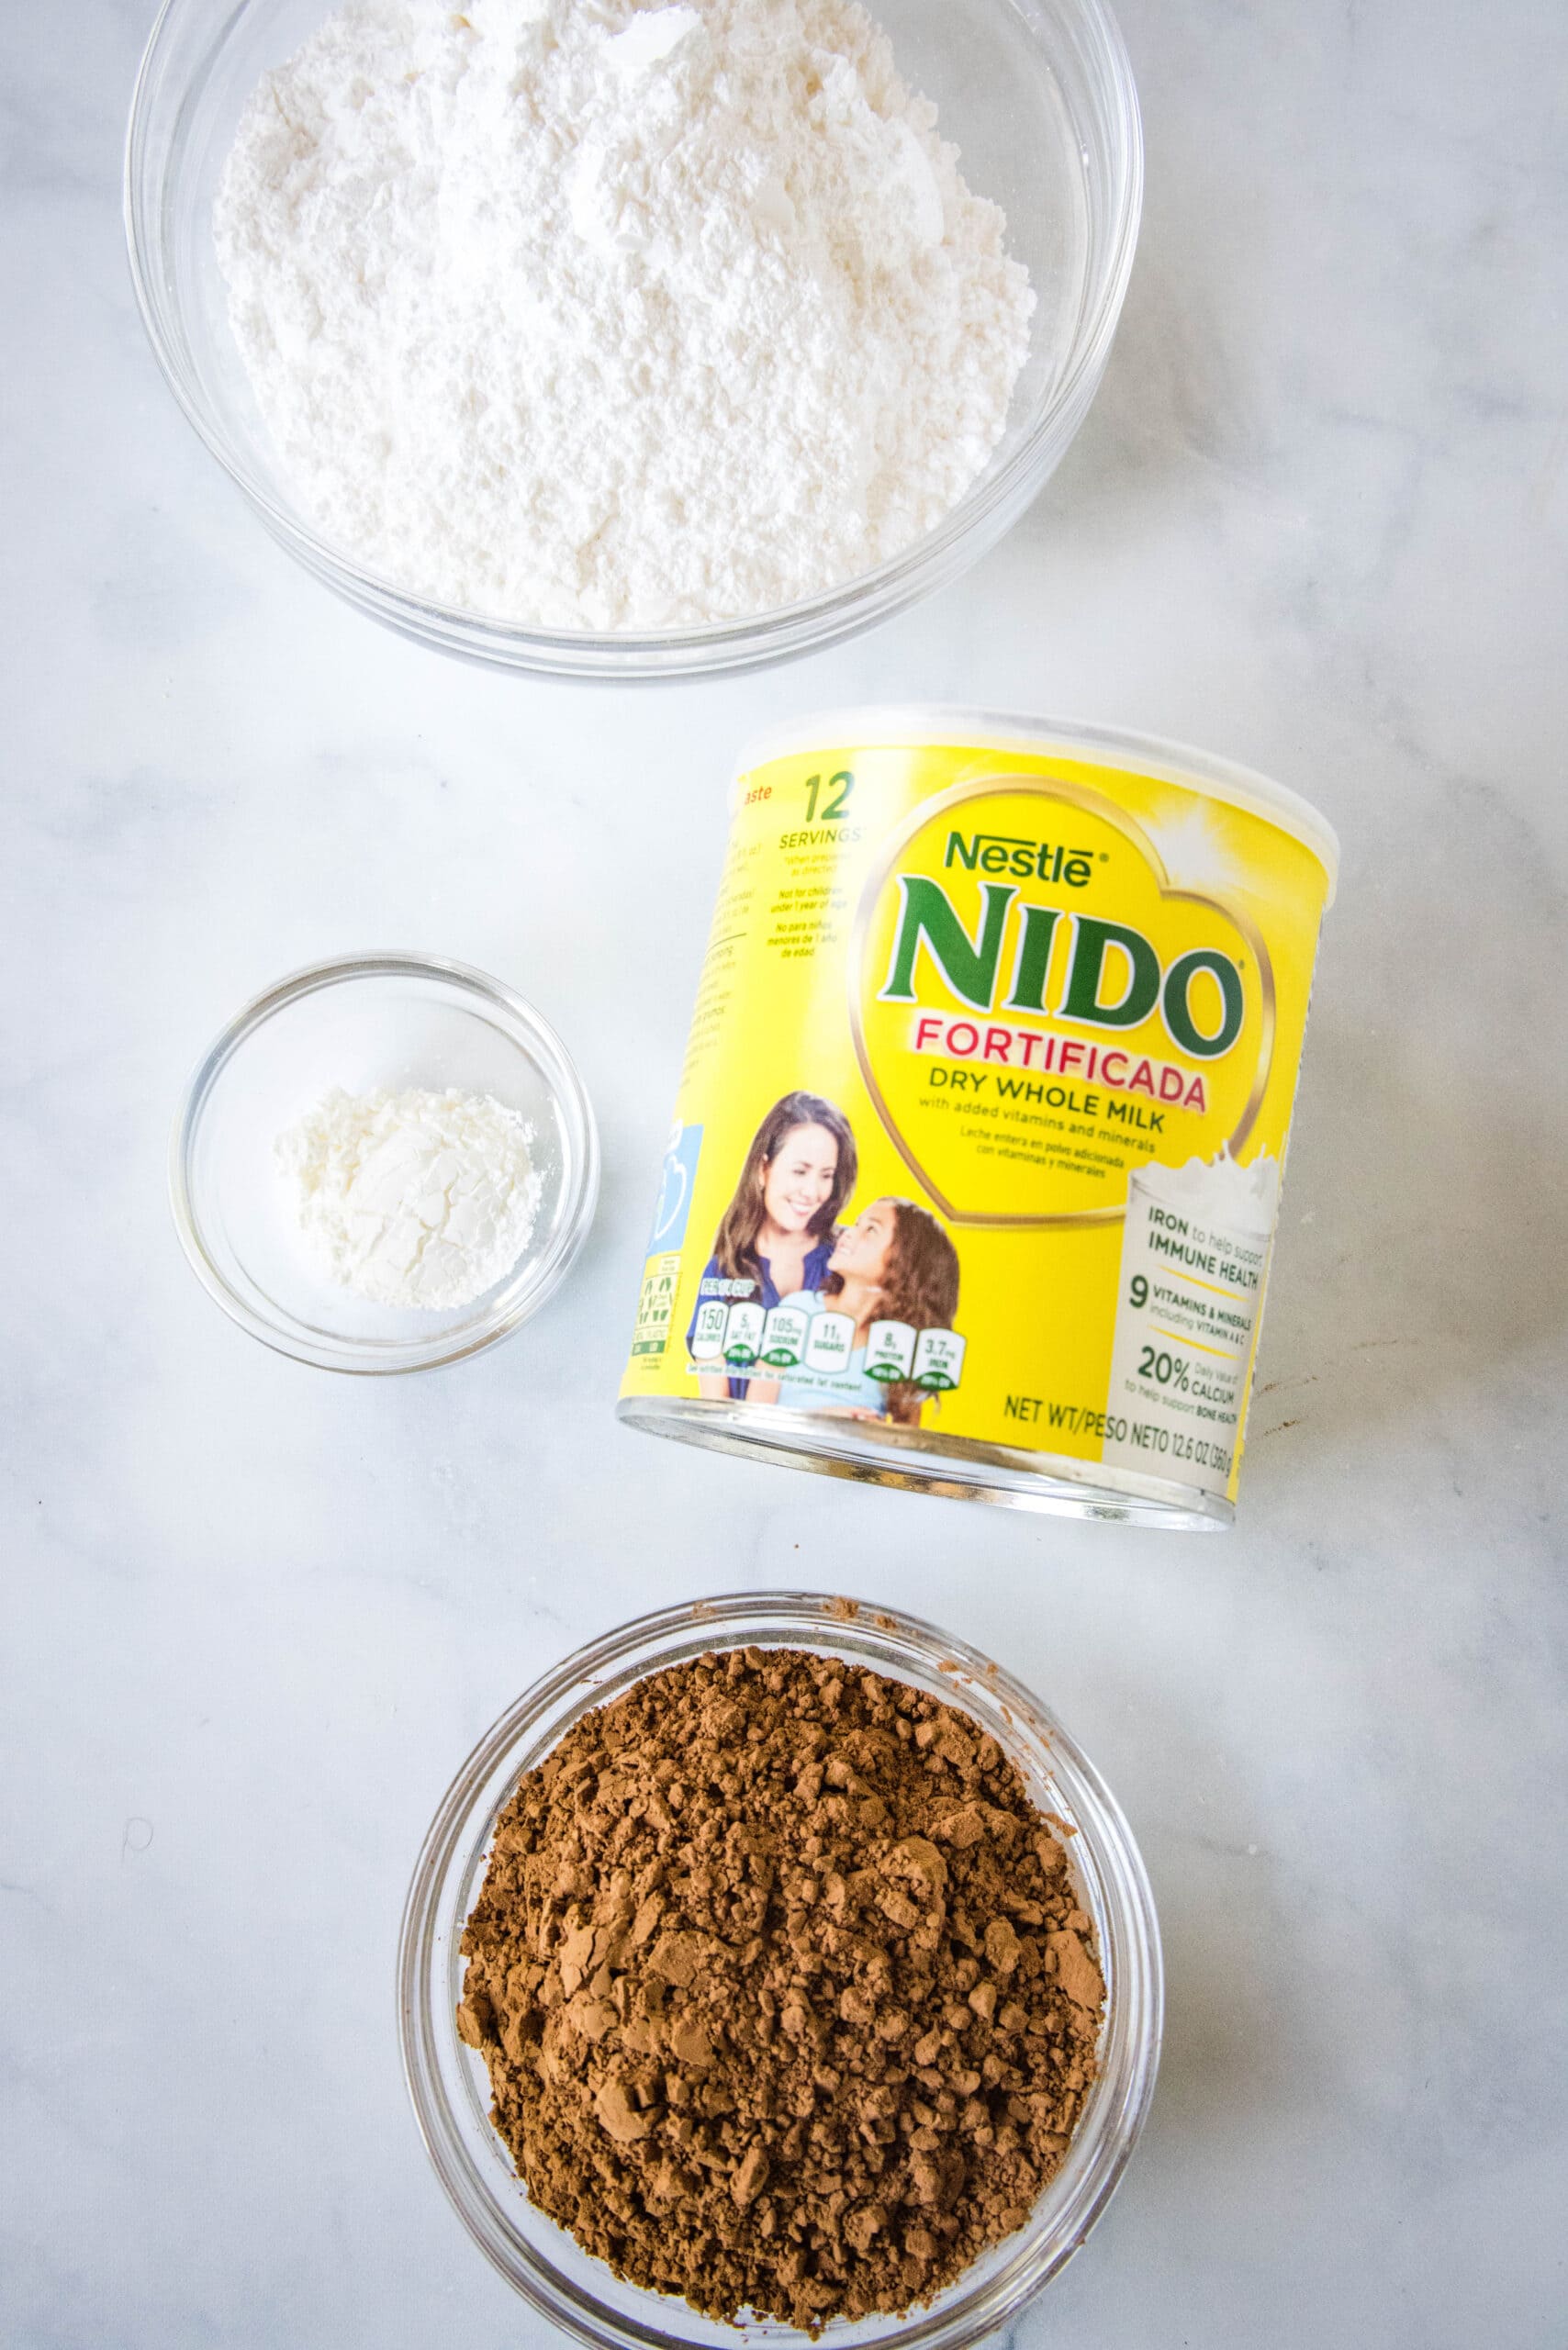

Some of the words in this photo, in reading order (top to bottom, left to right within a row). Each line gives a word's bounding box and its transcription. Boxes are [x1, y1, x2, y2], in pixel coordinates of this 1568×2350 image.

[805, 771, 855, 822] 12
[771, 902, 792, 914] under
[800, 901, 817, 912] year
[819, 900, 829, 909] of
[778, 890, 793, 900] Not
[794, 888, 806, 898] for
[767, 935, 801, 946] menores
[801, 934, 812, 944] de
[776, 923, 787, 933] No
[789, 922, 807, 933] para
[780, 948, 792, 958] de
[793, 947, 815, 958] edad
[879, 874, 1244, 1059] NIDO
[915, 1018, 1206, 1113] FORTIFICADA
[929, 1067, 987, 1092] DRY
[997, 1077, 1099, 1116] WHOLE
[1107, 1101, 1166, 1134] MILK
[919, 1097, 949, 1110] with
[954, 1102, 998, 1119] added
[1003, 1109, 1065, 1131] vitamins
[1069, 1121, 1094, 1137] and
[1098, 1129, 1156, 1154] minerals
[960, 1125, 991, 1140] Leche
[994, 1131, 1027, 1147] entera
[1030, 1138, 1043, 1149] en
[1045, 1139, 1071, 1158] polvo
[1074, 1147, 1125, 1169] adicionada
[976, 1144, 995, 1156] con
[997, 1147, 1047, 1166] vitaminas
[1048, 1158, 1055, 1169] y
[1057, 1158, 1106, 1179] minerales
[1148, 1205, 1189, 1236] IRON
[1193, 1226, 1205, 1243] to
[1209, 1231, 1232, 1256] help
[1148, 1231, 1216, 1275] IMMUNE
[1219, 1260, 1259, 1291] HEALTH
[1129, 1274, 1148, 1309] 9
[1152, 1285, 1206, 1316] VITAMINS
[701, 1308, 723, 1330] 150
[1149, 1305, 1193, 1329] including
[1196, 1320, 1228, 1339] VITAMIN
[1137, 1346, 1190, 1392] 20%
[1125, 1380, 1137, 1393] to
[1137, 1385, 1160, 1403] help
[1162, 1393, 1194, 1413] support
[1196, 1405, 1216, 1421] BONE
[1192, 1381, 1234, 1404] CALCIUM
[1003, 1394, 1043, 1423] NET
[1047, 1402, 1127, 1442] WT/PESO
[1130, 1424, 1168, 1453] NETO
[1172, 1433, 1193, 1460] 12.6
[1195, 1440, 1210, 1465] OZ
